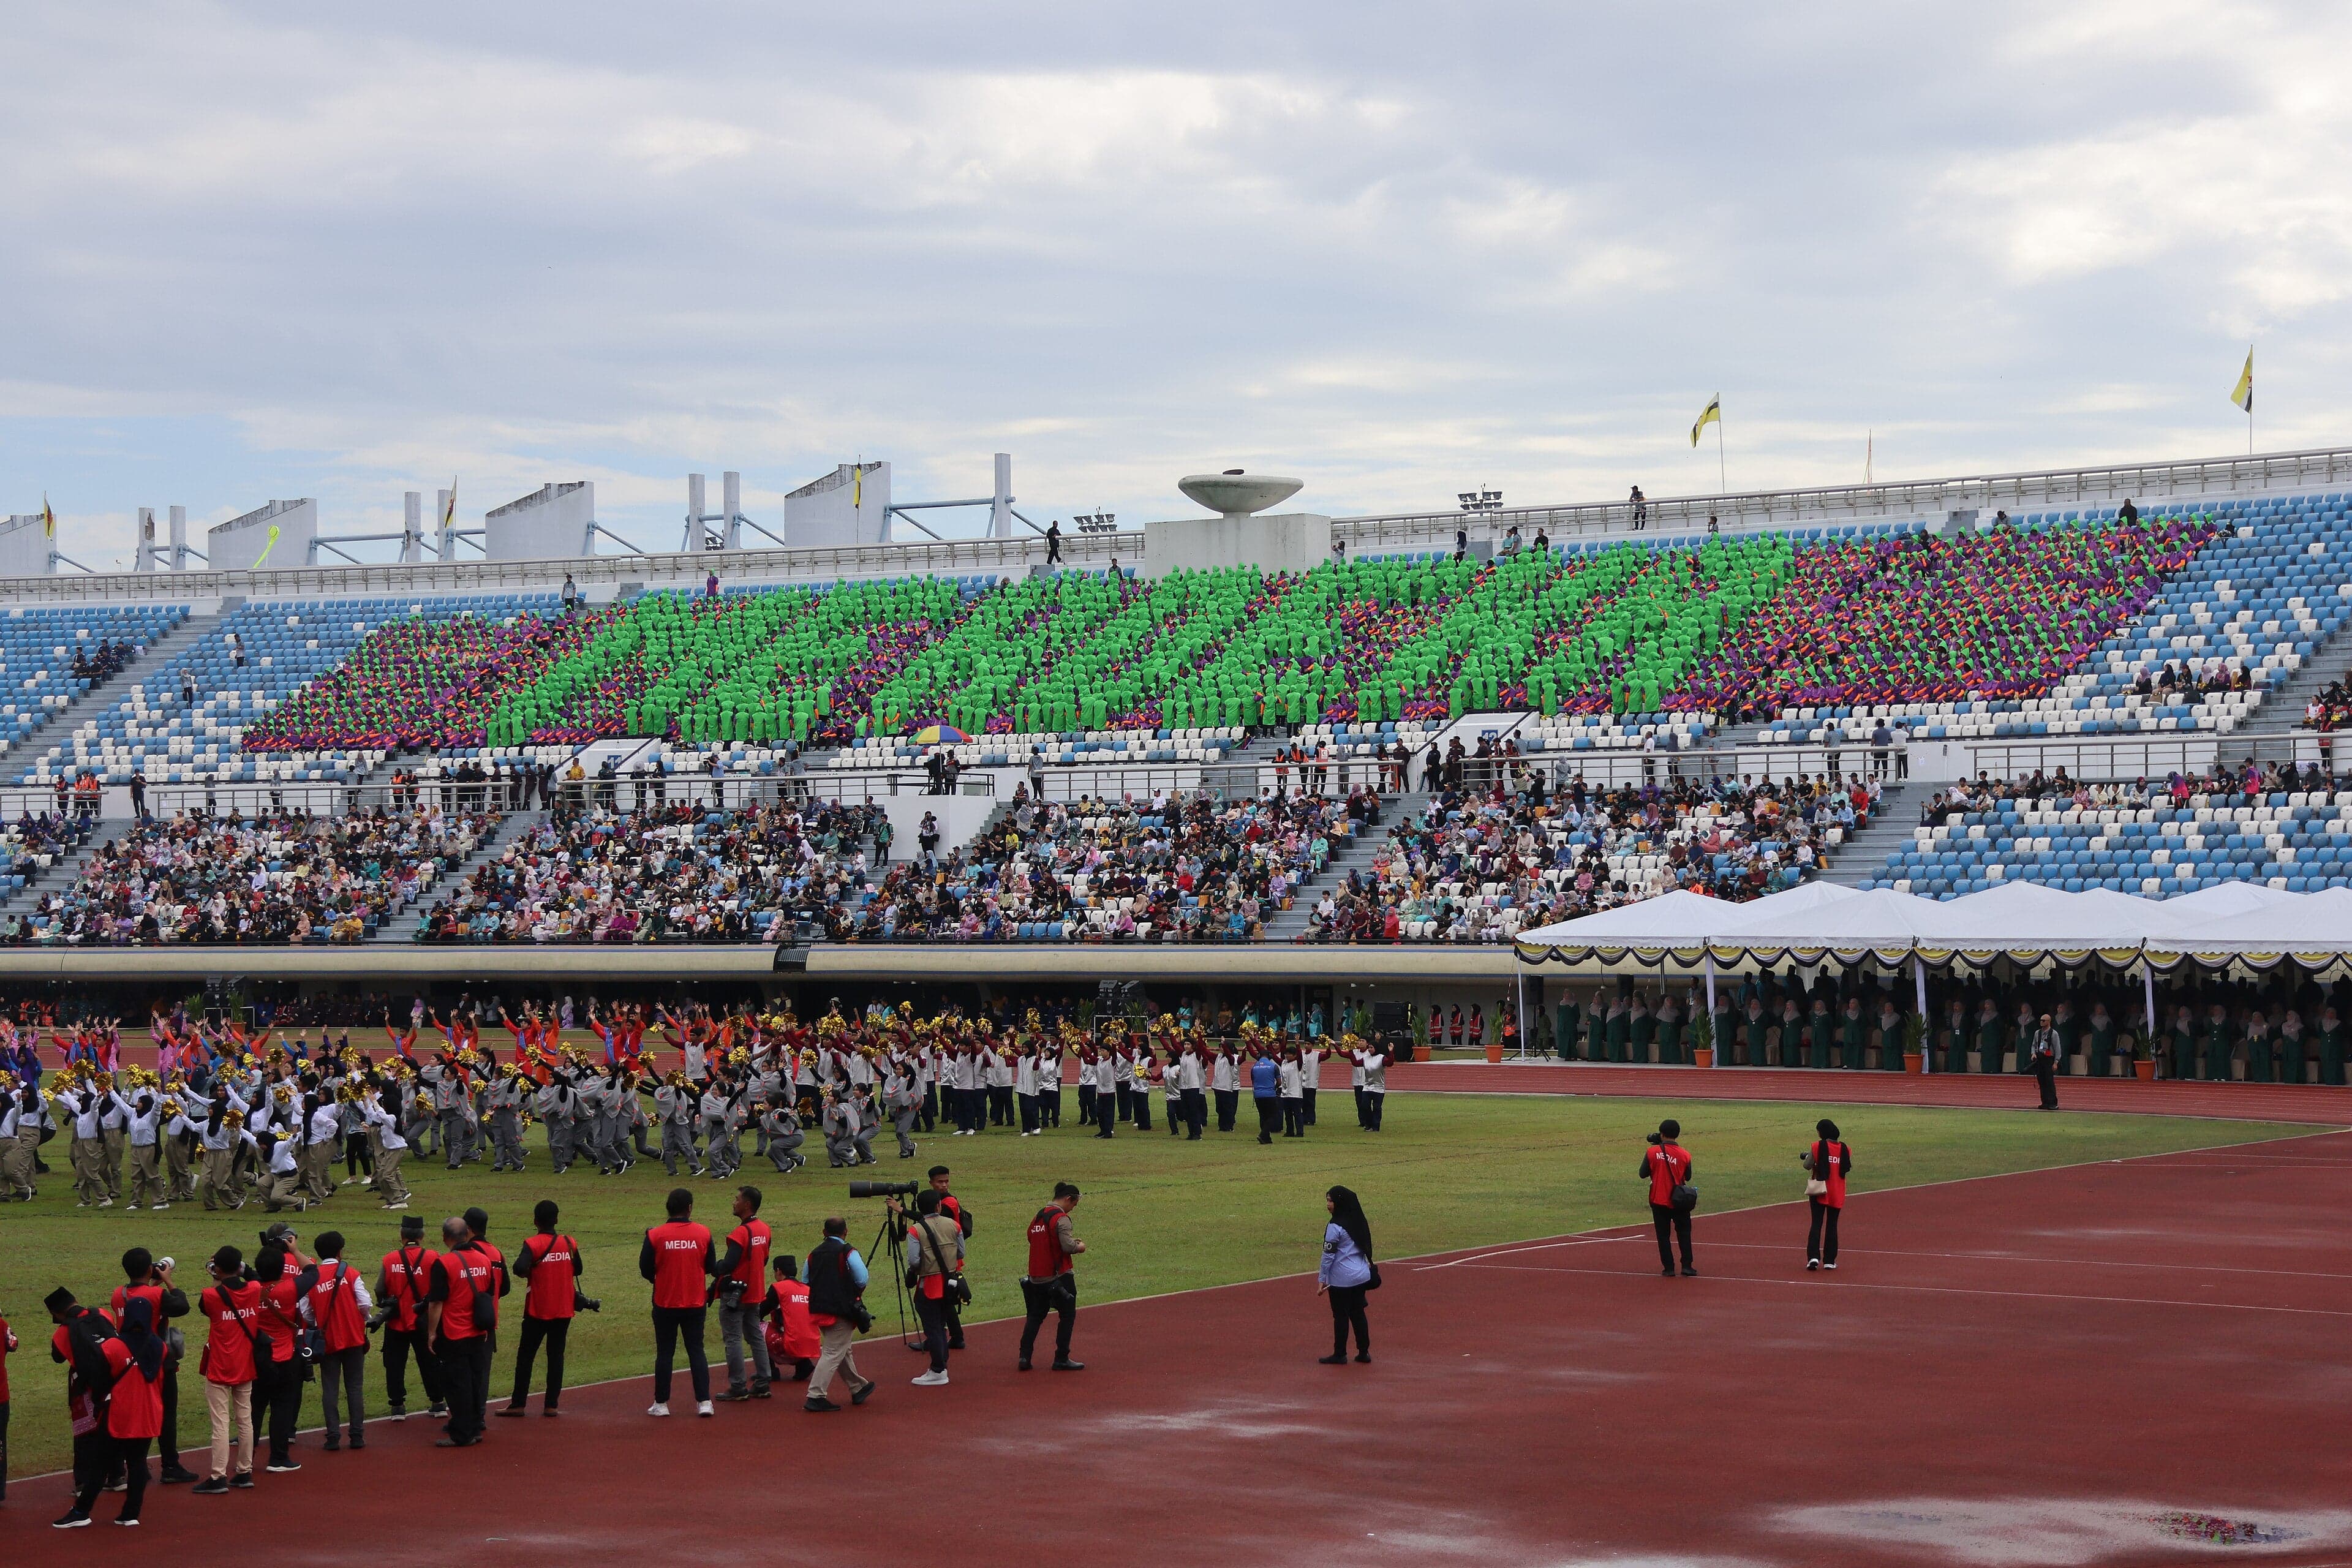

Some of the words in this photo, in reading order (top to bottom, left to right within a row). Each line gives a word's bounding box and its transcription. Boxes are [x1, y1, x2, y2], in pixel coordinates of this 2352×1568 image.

[665, 1240, 698, 1250] MEDIA
[542, 1251, 571, 1262] MEDIA
[392, 1264, 423, 1275] MEA
[461, 1267, 487, 1278] MEDIA
[317, 1276, 348, 1294] MEDA
